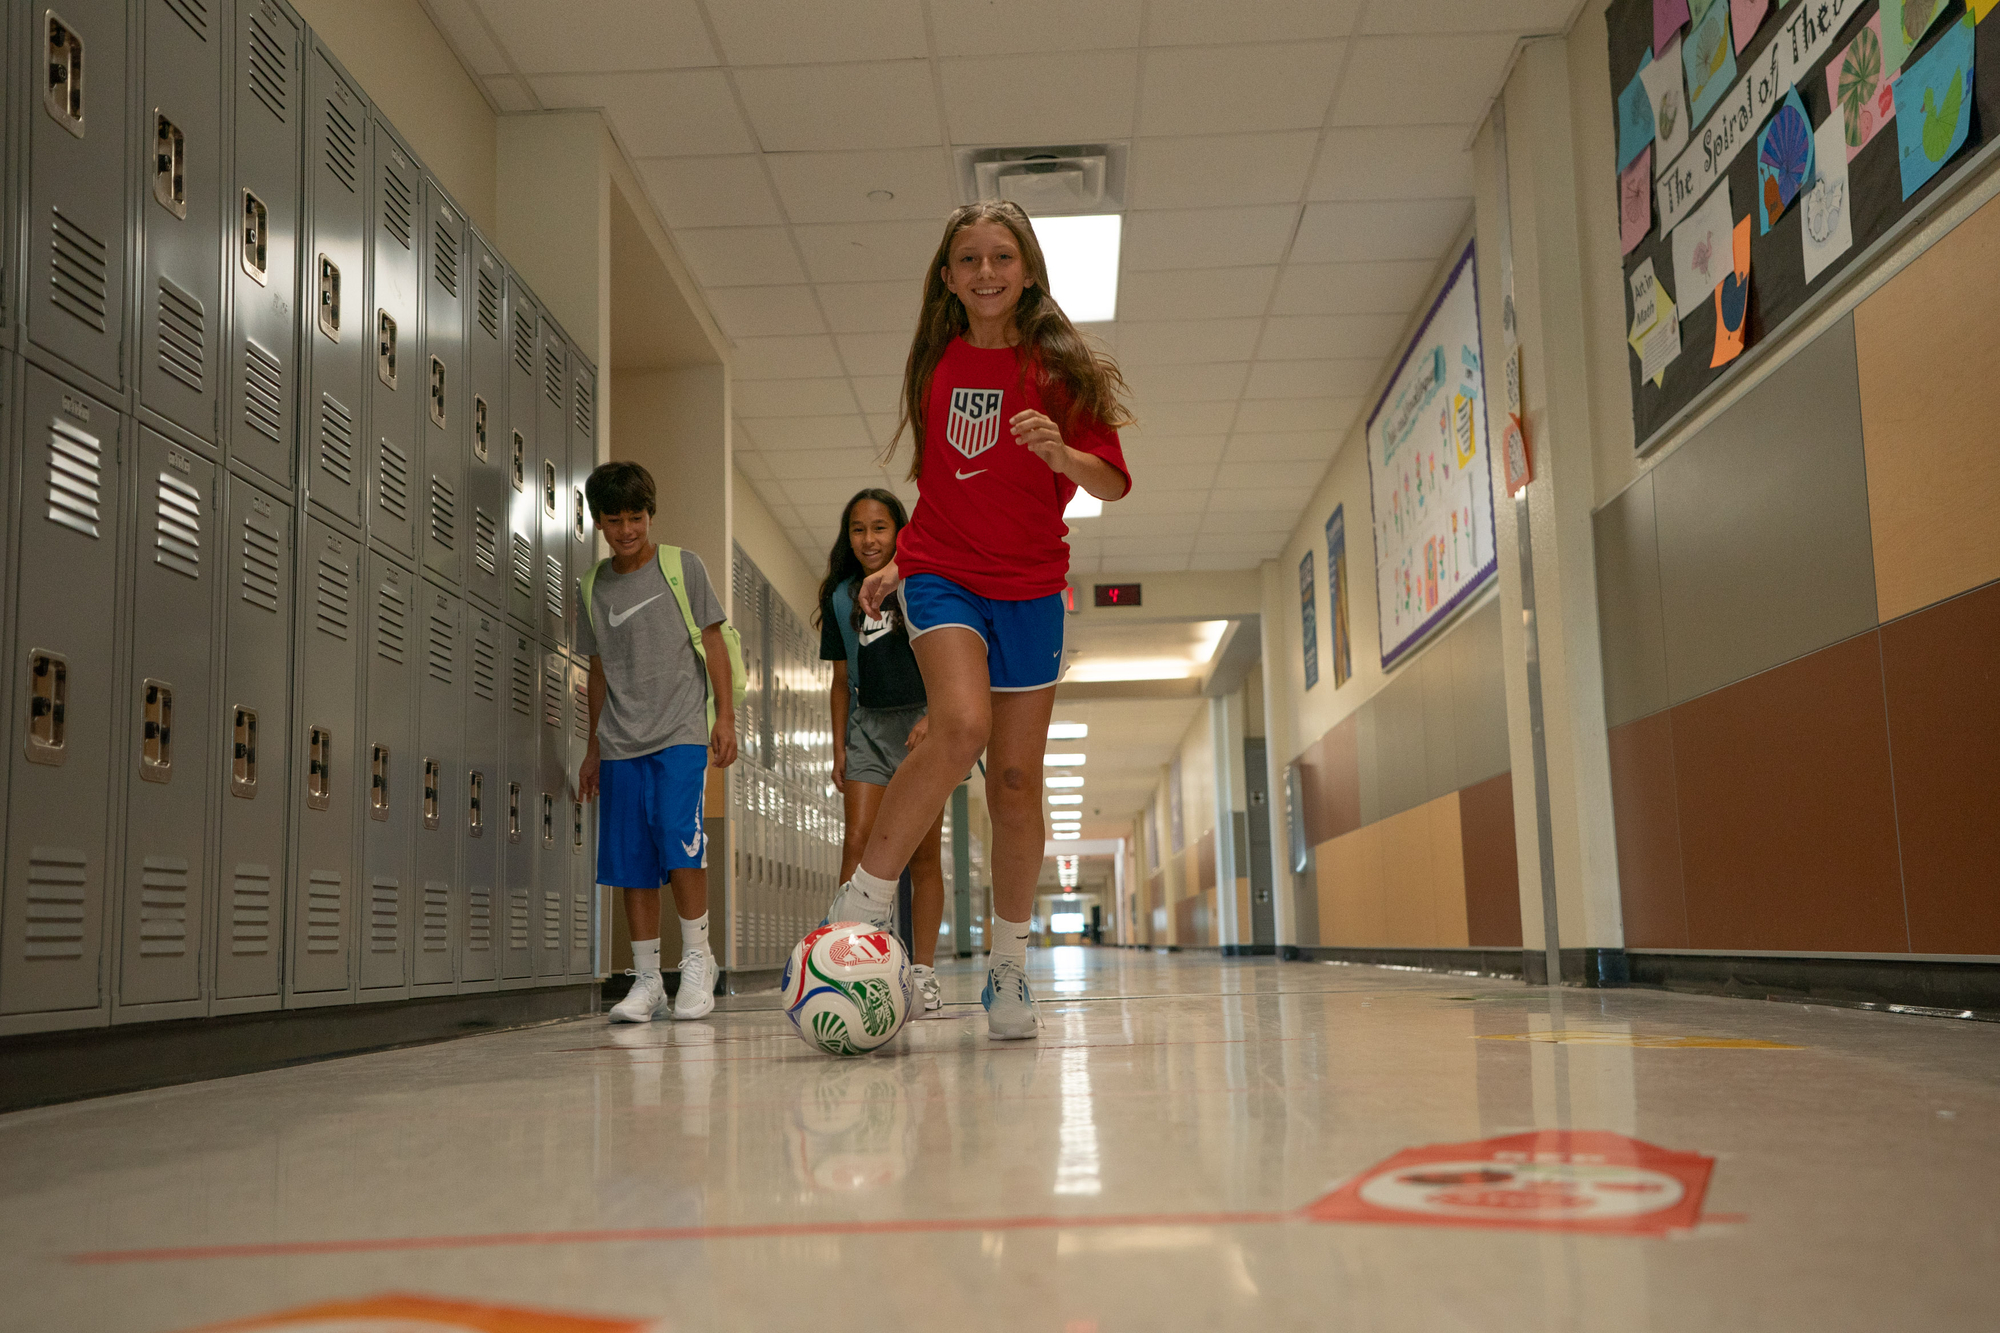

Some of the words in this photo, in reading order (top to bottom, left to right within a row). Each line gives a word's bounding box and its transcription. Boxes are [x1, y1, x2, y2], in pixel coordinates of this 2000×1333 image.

[1663, 166, 1693, 213] The
[1703, 74, 1753, 175] Spiral
[1758, 41, 1779, 108] of
[1635, 281, 1646, 302] Art
[1644, 273, 1654, 291] in
[1636, 300, 1655, 326] Math
[954, 392, 1000, 419] USA
[877, 984, 893, 1022] TRIONDA
